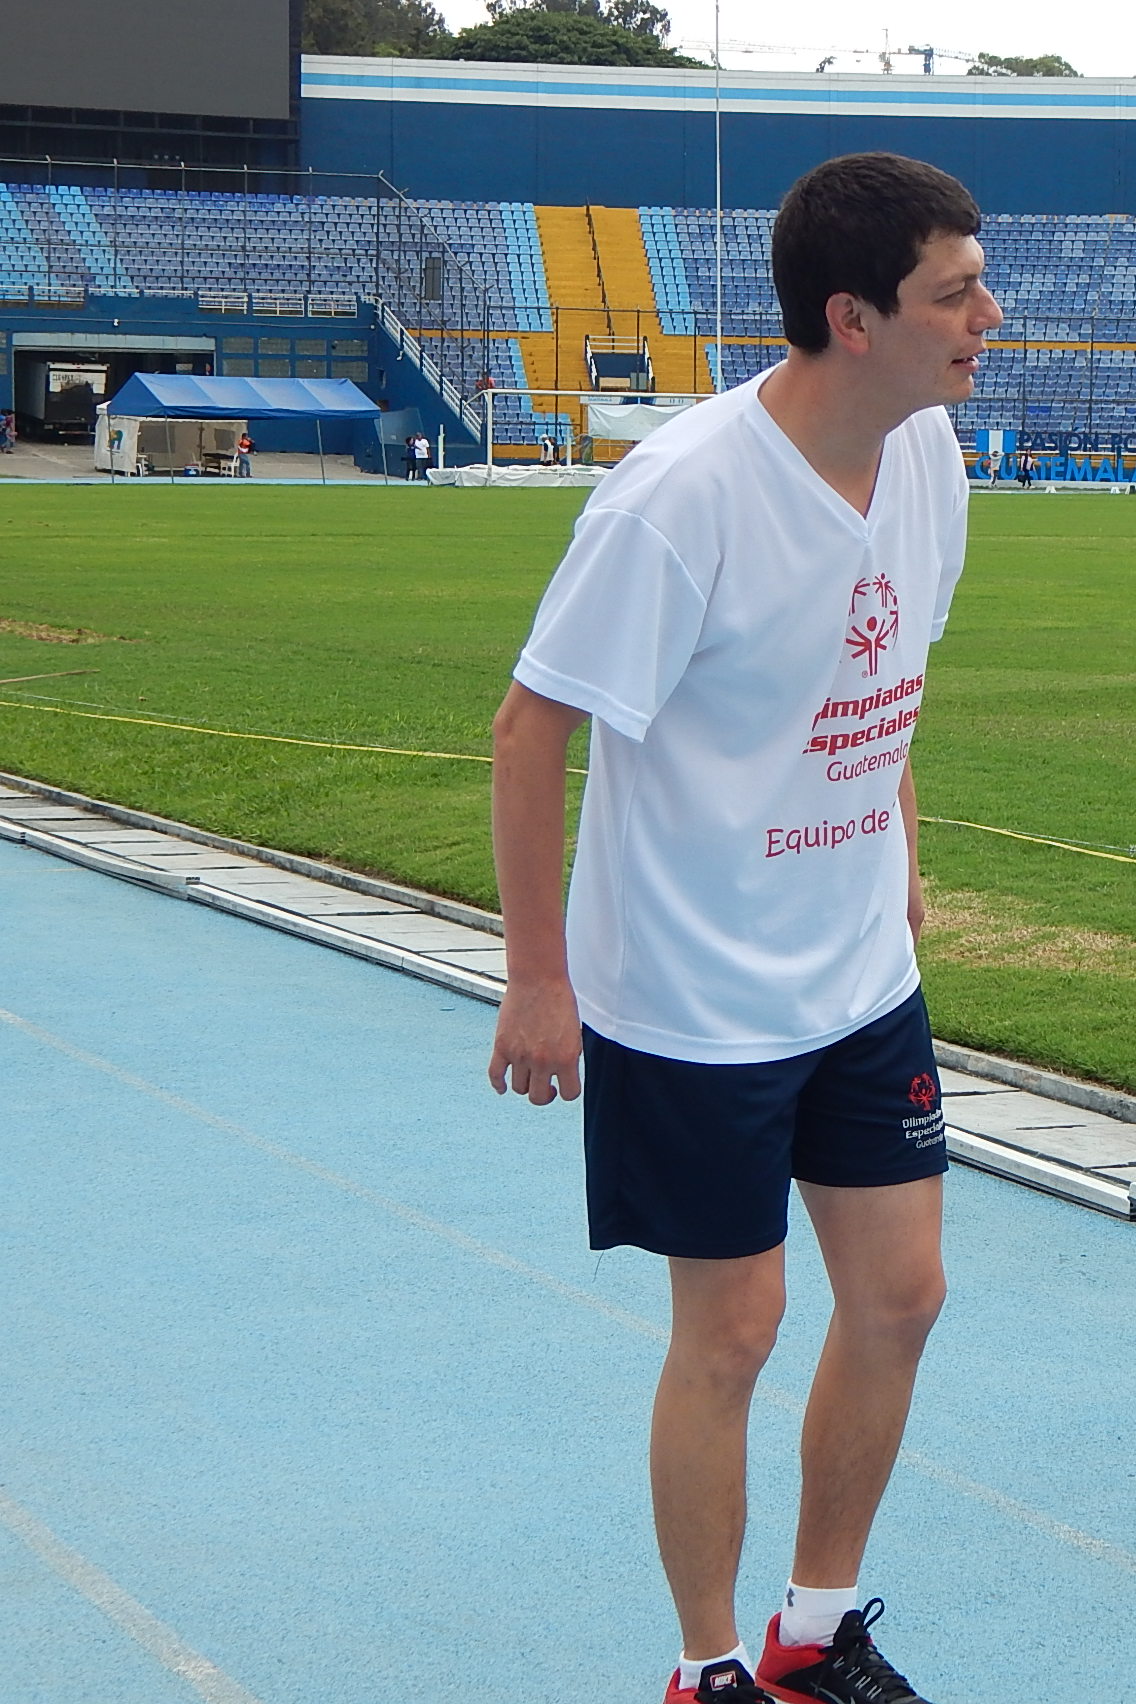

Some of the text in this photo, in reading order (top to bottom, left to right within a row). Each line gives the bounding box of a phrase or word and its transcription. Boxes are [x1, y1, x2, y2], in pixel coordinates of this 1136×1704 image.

[1017, 426, 1100, 453] PASIÓN
[811, 673, 924, 732] limpiadas
[802, 705, 920, 756] speciales
[826, 742, 909, 782] Guatemala
[765, 808, 890, 858] Equipo de
